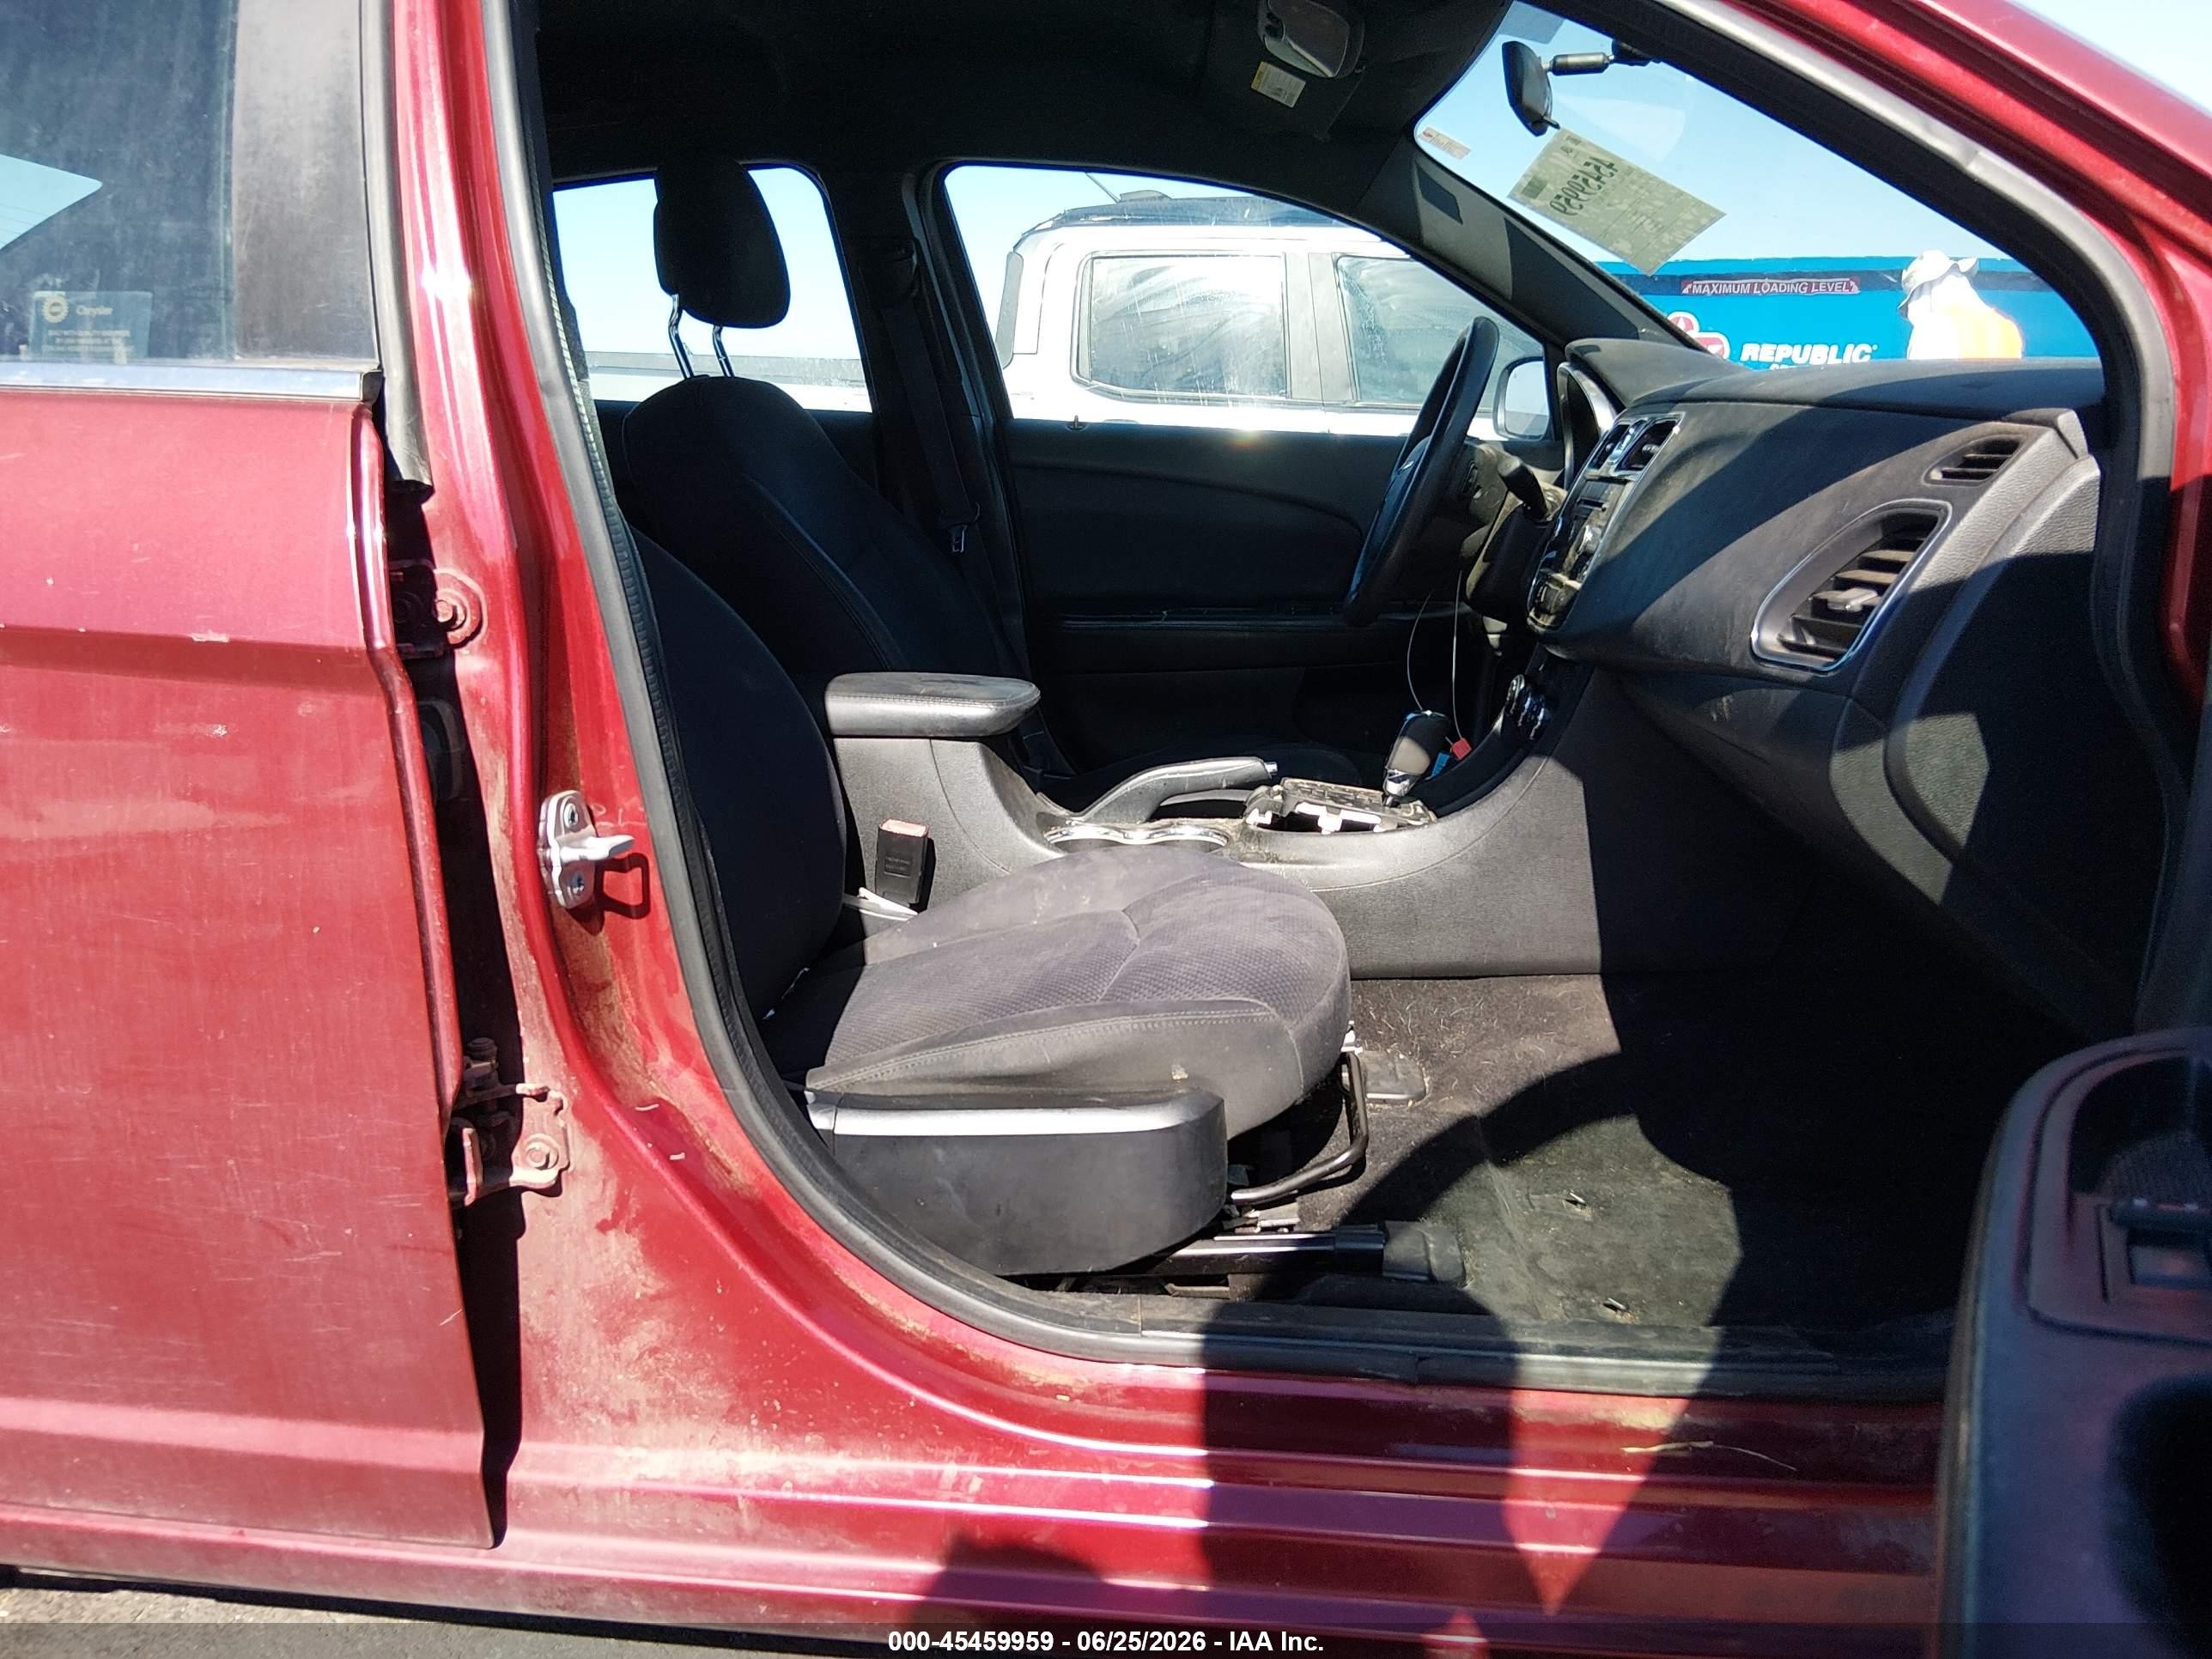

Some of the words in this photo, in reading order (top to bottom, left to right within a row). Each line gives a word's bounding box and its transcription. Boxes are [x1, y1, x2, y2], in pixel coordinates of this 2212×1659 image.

[1692, 282, 1751, 295] MAXIMUM
[1753, 281, 1808, 294] LOADING
[1811, 280, 1850, 293] LEVEL
[1740, 343, 1873, 365] REPUBLIC
